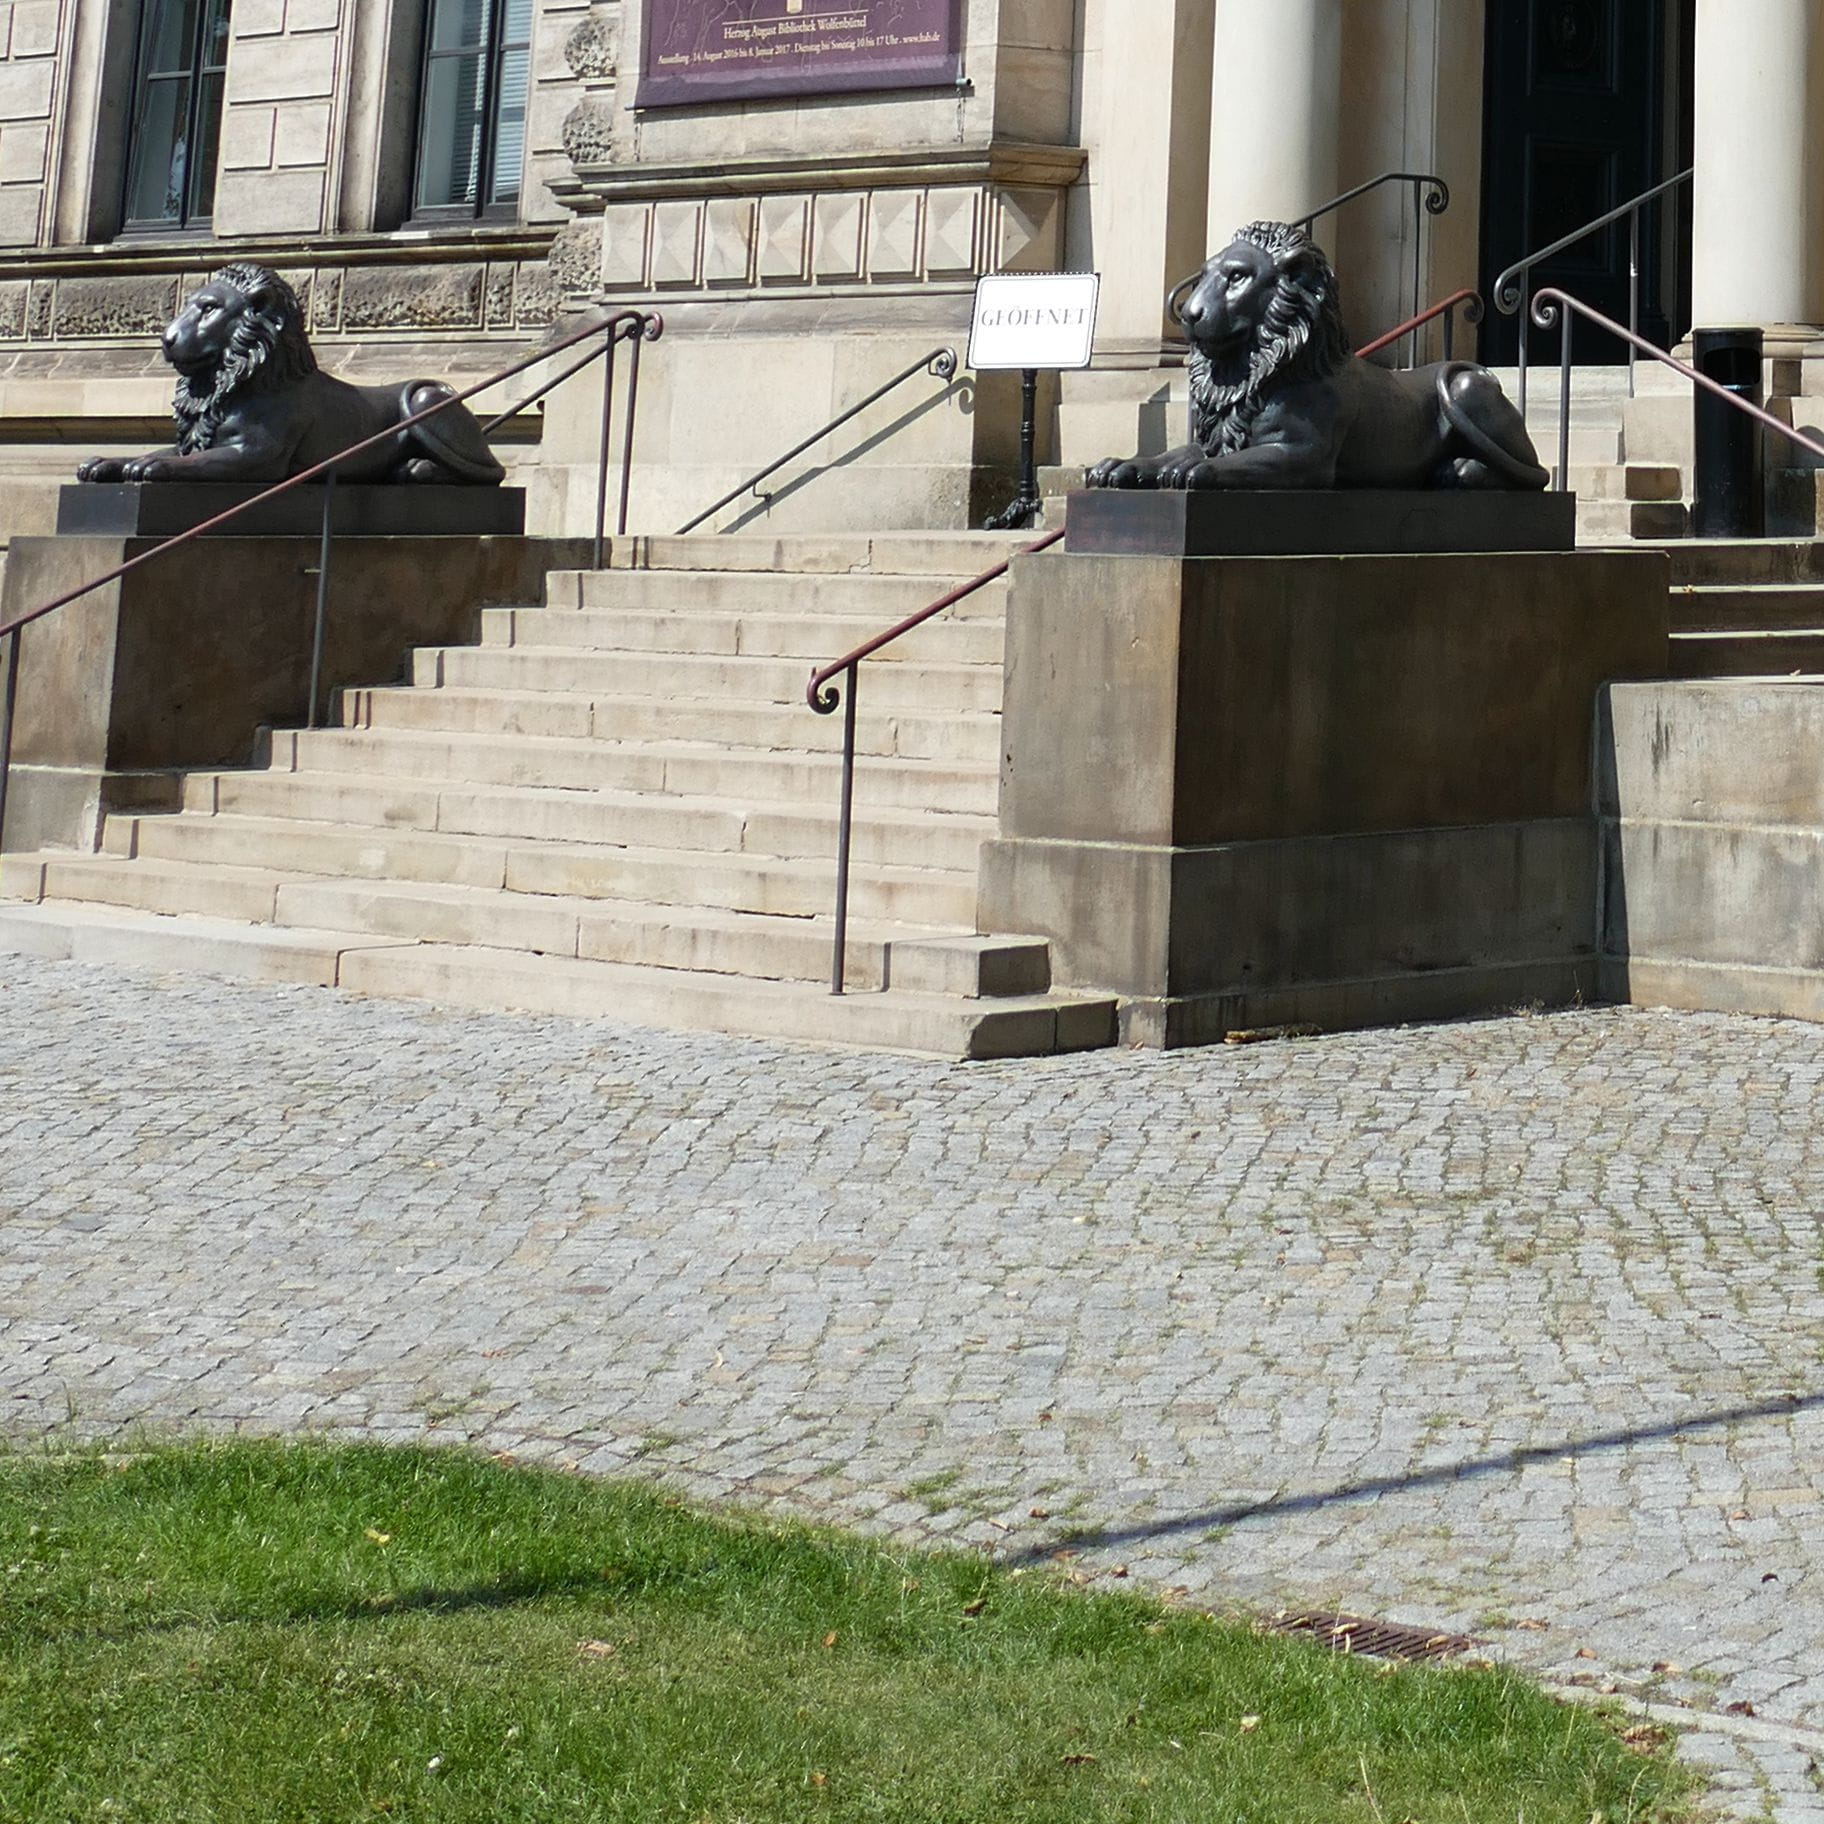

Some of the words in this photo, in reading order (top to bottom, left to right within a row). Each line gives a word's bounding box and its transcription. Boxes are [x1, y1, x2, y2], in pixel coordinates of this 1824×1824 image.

[723, 27, 750, 41] Herzog
[751, 24, 777, 40] August
[778, 19, 816, 34] Bibliothek
[817, 15, 867, 30] Wolfenbüttel
[981, 305, 1088, 327] GEÖFFNET
